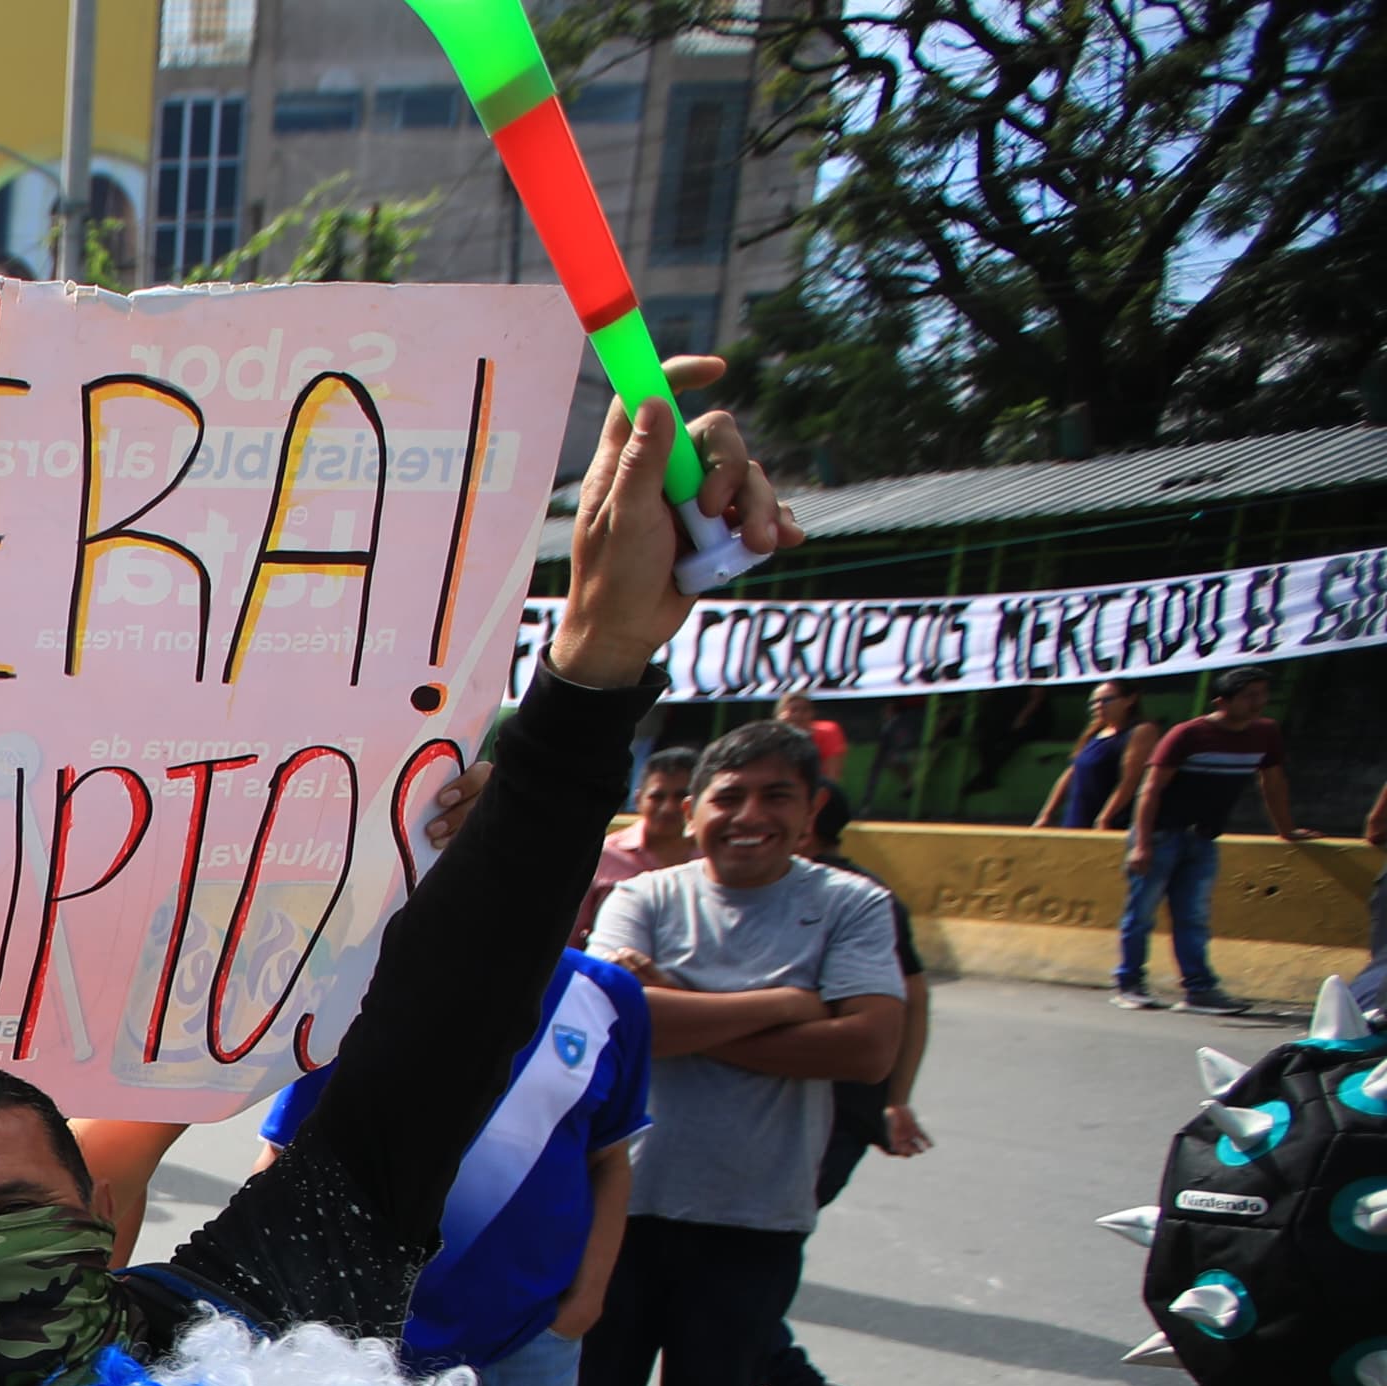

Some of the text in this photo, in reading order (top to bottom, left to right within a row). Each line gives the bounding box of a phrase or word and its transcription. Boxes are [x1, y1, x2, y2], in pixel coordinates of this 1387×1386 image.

[693, 600, 967, 695] CORRUPTOS
[993, 576, 1228, 681] MERCADO
[1239, 563, 1291, 654] EL
[1182, 1192, 1262, 1212] Nintendo
